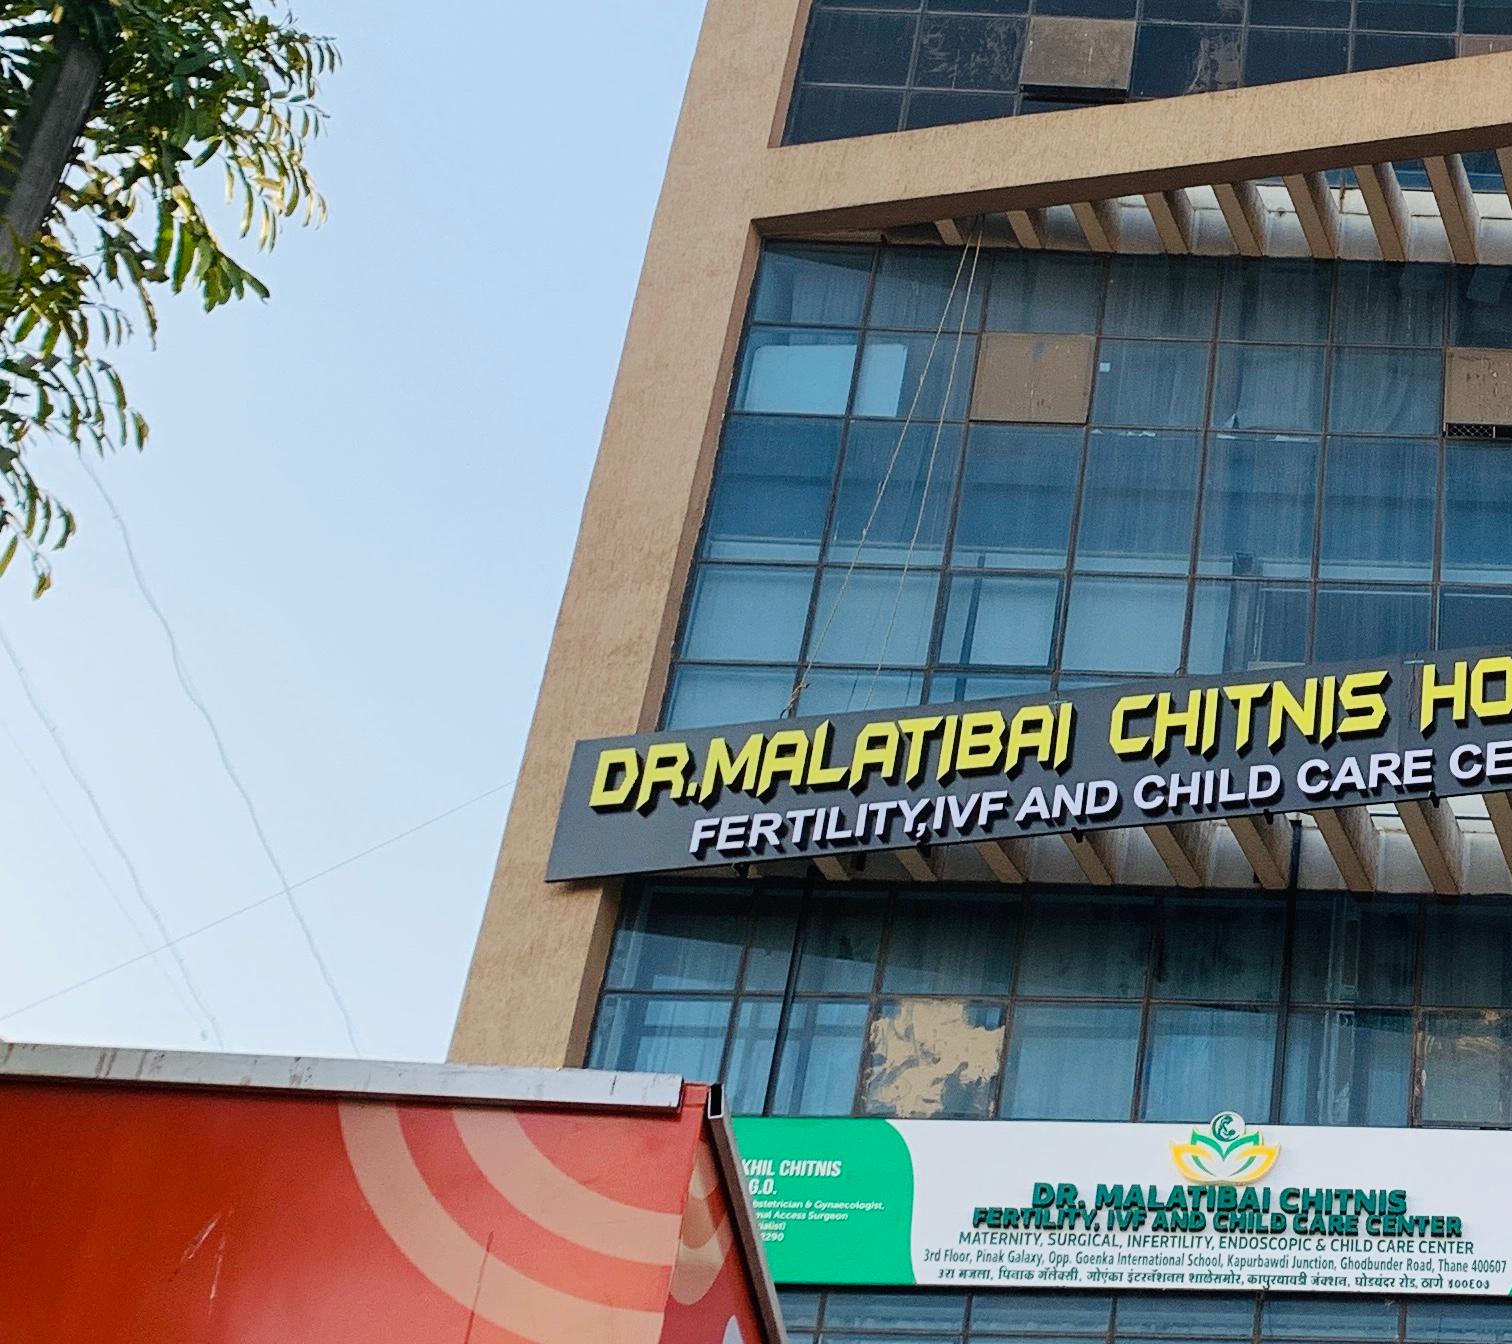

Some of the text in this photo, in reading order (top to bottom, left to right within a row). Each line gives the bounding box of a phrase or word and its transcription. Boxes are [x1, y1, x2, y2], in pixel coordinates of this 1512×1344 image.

[588, 701, 1073, 811] DR.MALATIBAI
[1108, 670, 1391, 760] CHITNIS
[689, 790, 1011, 856] FERTILITY,IVF
[1014, 780, 1119, 823] AND
[1133, 764, 1280, 811] CHILD
[1297, 751, 1433, 796] CARE
[741, 1159, 842, 1177] KHIL CHITNIS
[752, 1200, 802, 1209] bstetrician
[1032, 1182, 1407, 1216] DR. MALATIBAI CHITNIS
[808, 1211, 848, 1221] Surgeon
[972, 1207, 1463, 1238] FERTILITY, IVF AND CHILD CARE CENTER
[959, 1231, 1474, 1255] MATERNITY, SURGICAL, INFERTILITY, ENDOSCOPIC & CHILD CARE CENTER
[923, 1249, 1507, 1274] 3rd Floor, Pinak Galaxy, Opp. Goenka International School, Kapurbawdi Junction, Ghodbunder Road, Thane 400607
